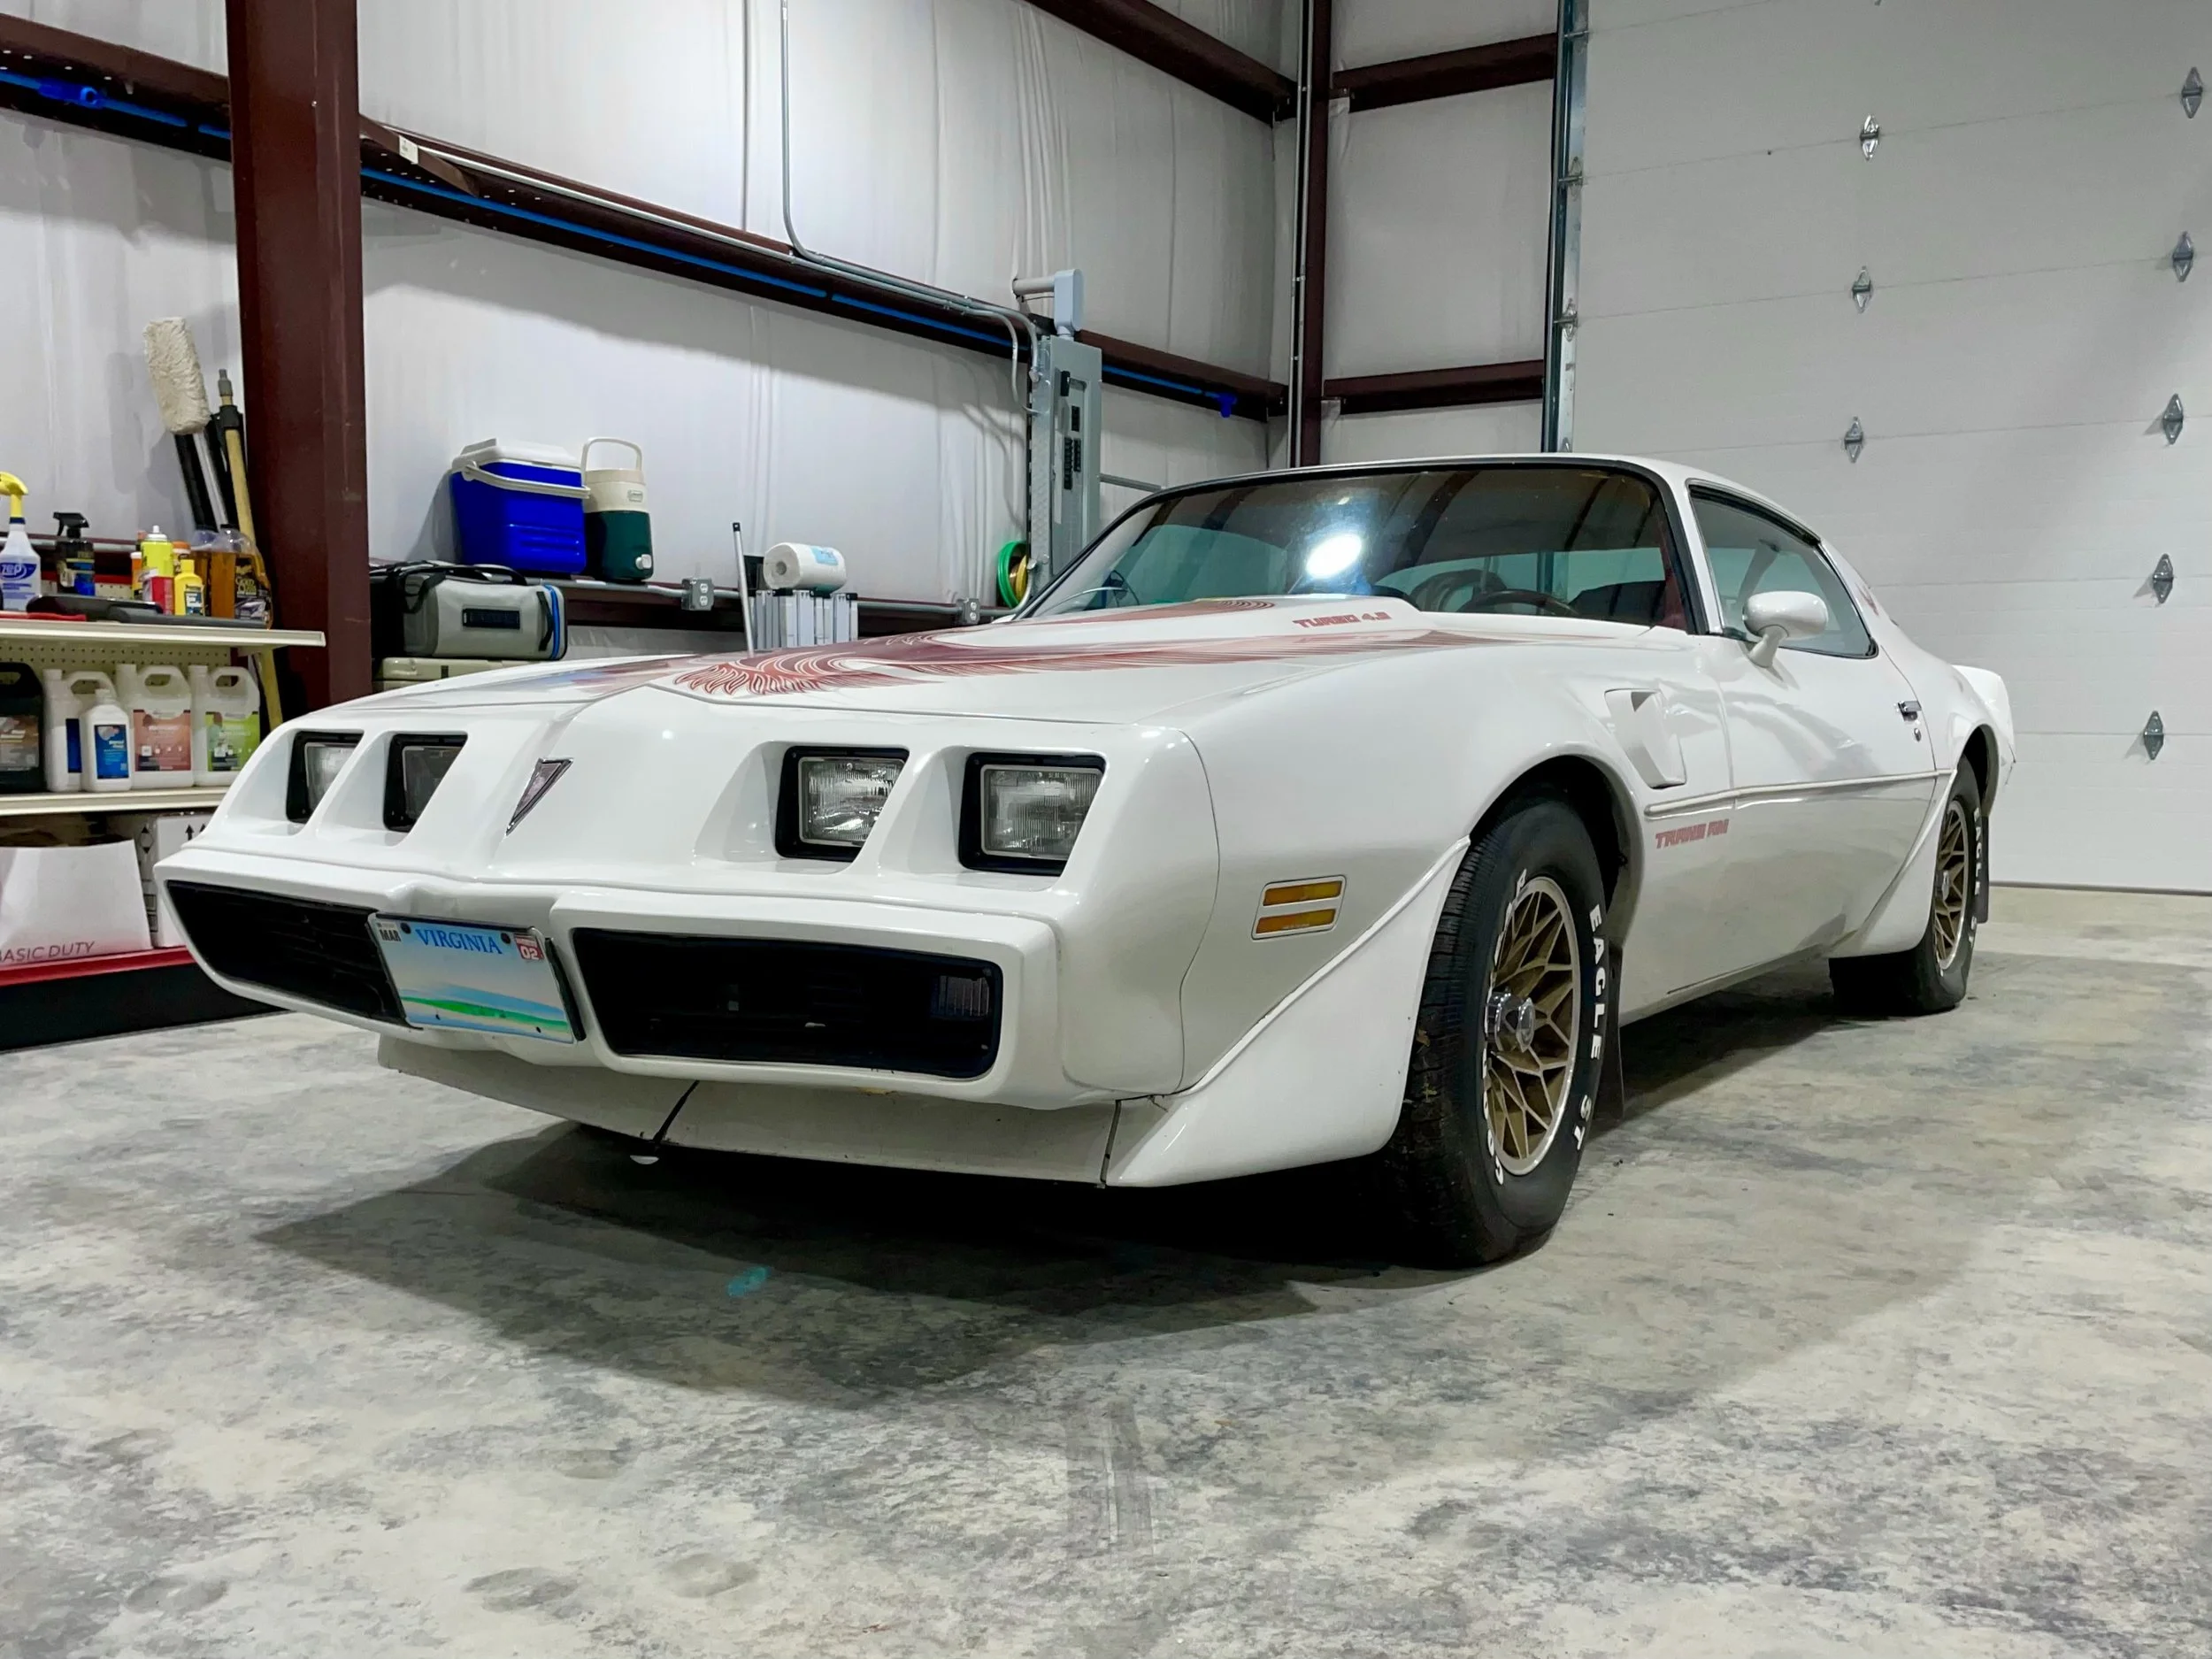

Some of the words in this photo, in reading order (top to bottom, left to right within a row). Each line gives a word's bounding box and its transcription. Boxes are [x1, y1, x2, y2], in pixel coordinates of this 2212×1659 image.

[1292, 614, 1361, 628] TURBO
[1655, 823, 1707, 849] TRANS
[1707, 818, 1730, 838] AM
[379, 929, 402, 942] MAR
[415, 929, 503, 954] VIRGINIA
[49, 941, 96, 958] DUTY
[520, 945, 540, 960] 02
[1589, 903, 1606, 1061] EAGLE
[1573, 1094, 1592, 1151] ST
